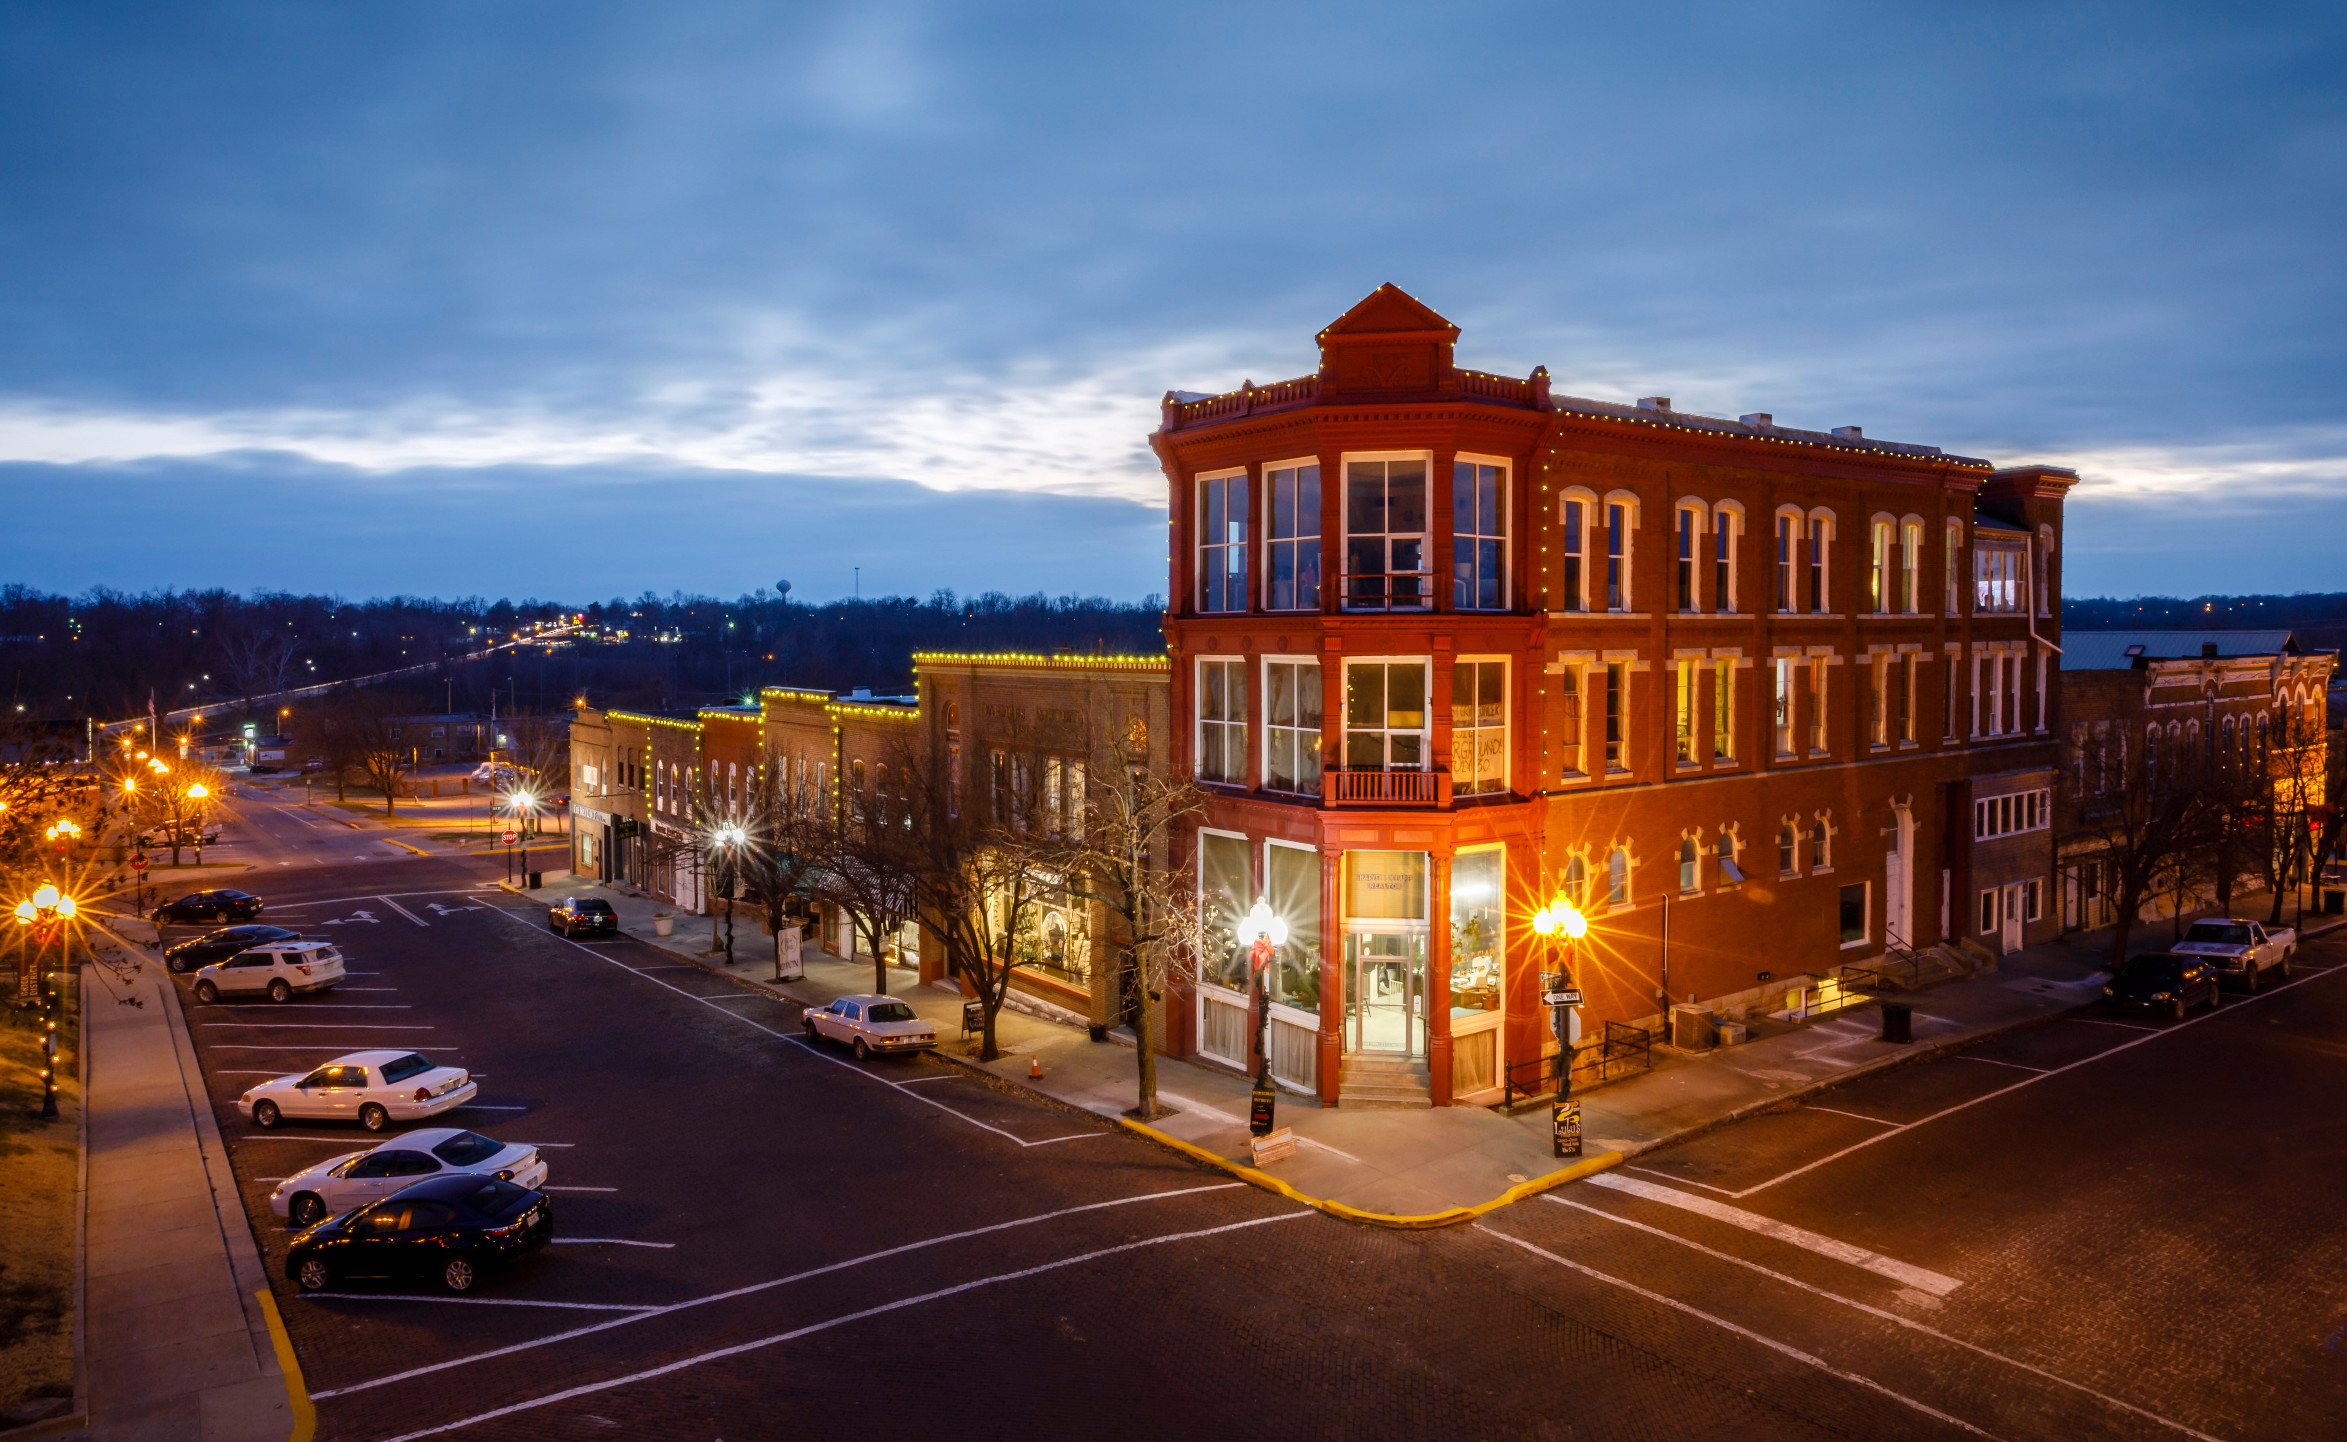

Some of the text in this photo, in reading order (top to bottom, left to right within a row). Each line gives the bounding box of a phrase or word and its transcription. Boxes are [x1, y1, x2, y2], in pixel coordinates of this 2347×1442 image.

[21, 975, 29, 997] BRICK
[30, 965, 38, 996] DISTRICT
[1554, 1117, 1580, 1135] Lulu's
